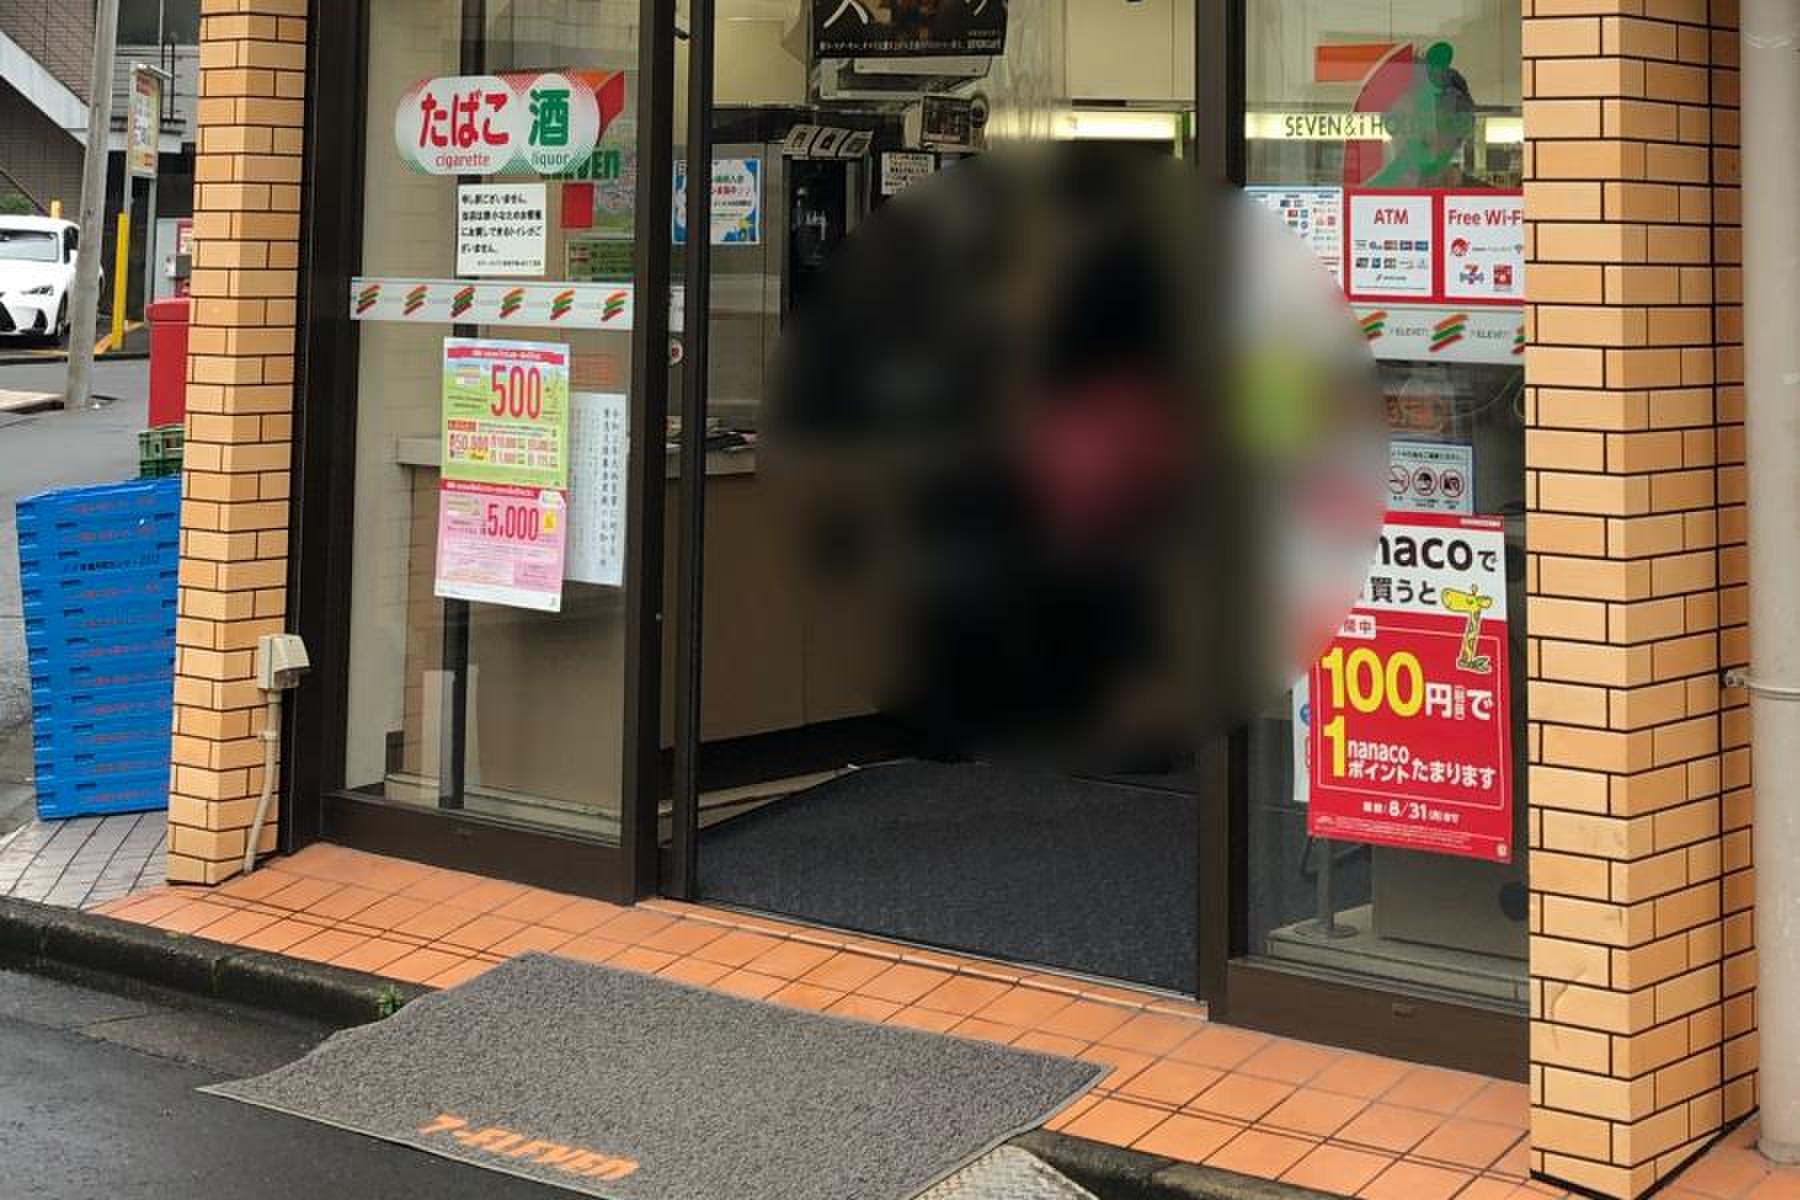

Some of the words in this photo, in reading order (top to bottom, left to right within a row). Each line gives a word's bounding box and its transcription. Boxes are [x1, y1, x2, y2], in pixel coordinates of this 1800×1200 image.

[419, 88, 510, 148] たばこ
[528, 89, 571, 147] 酒
[435, 152, 491, 168] cigarette
[531, 151, 571, 168] liquor
[1374, 207, 1410, 225] ATM
[1448, 208, 1481, 226] Free
[491, 364, 542, 420] 500
[488, 504, 539, 542] 5,000
[1347, 739, 1409, 764] nanaco
